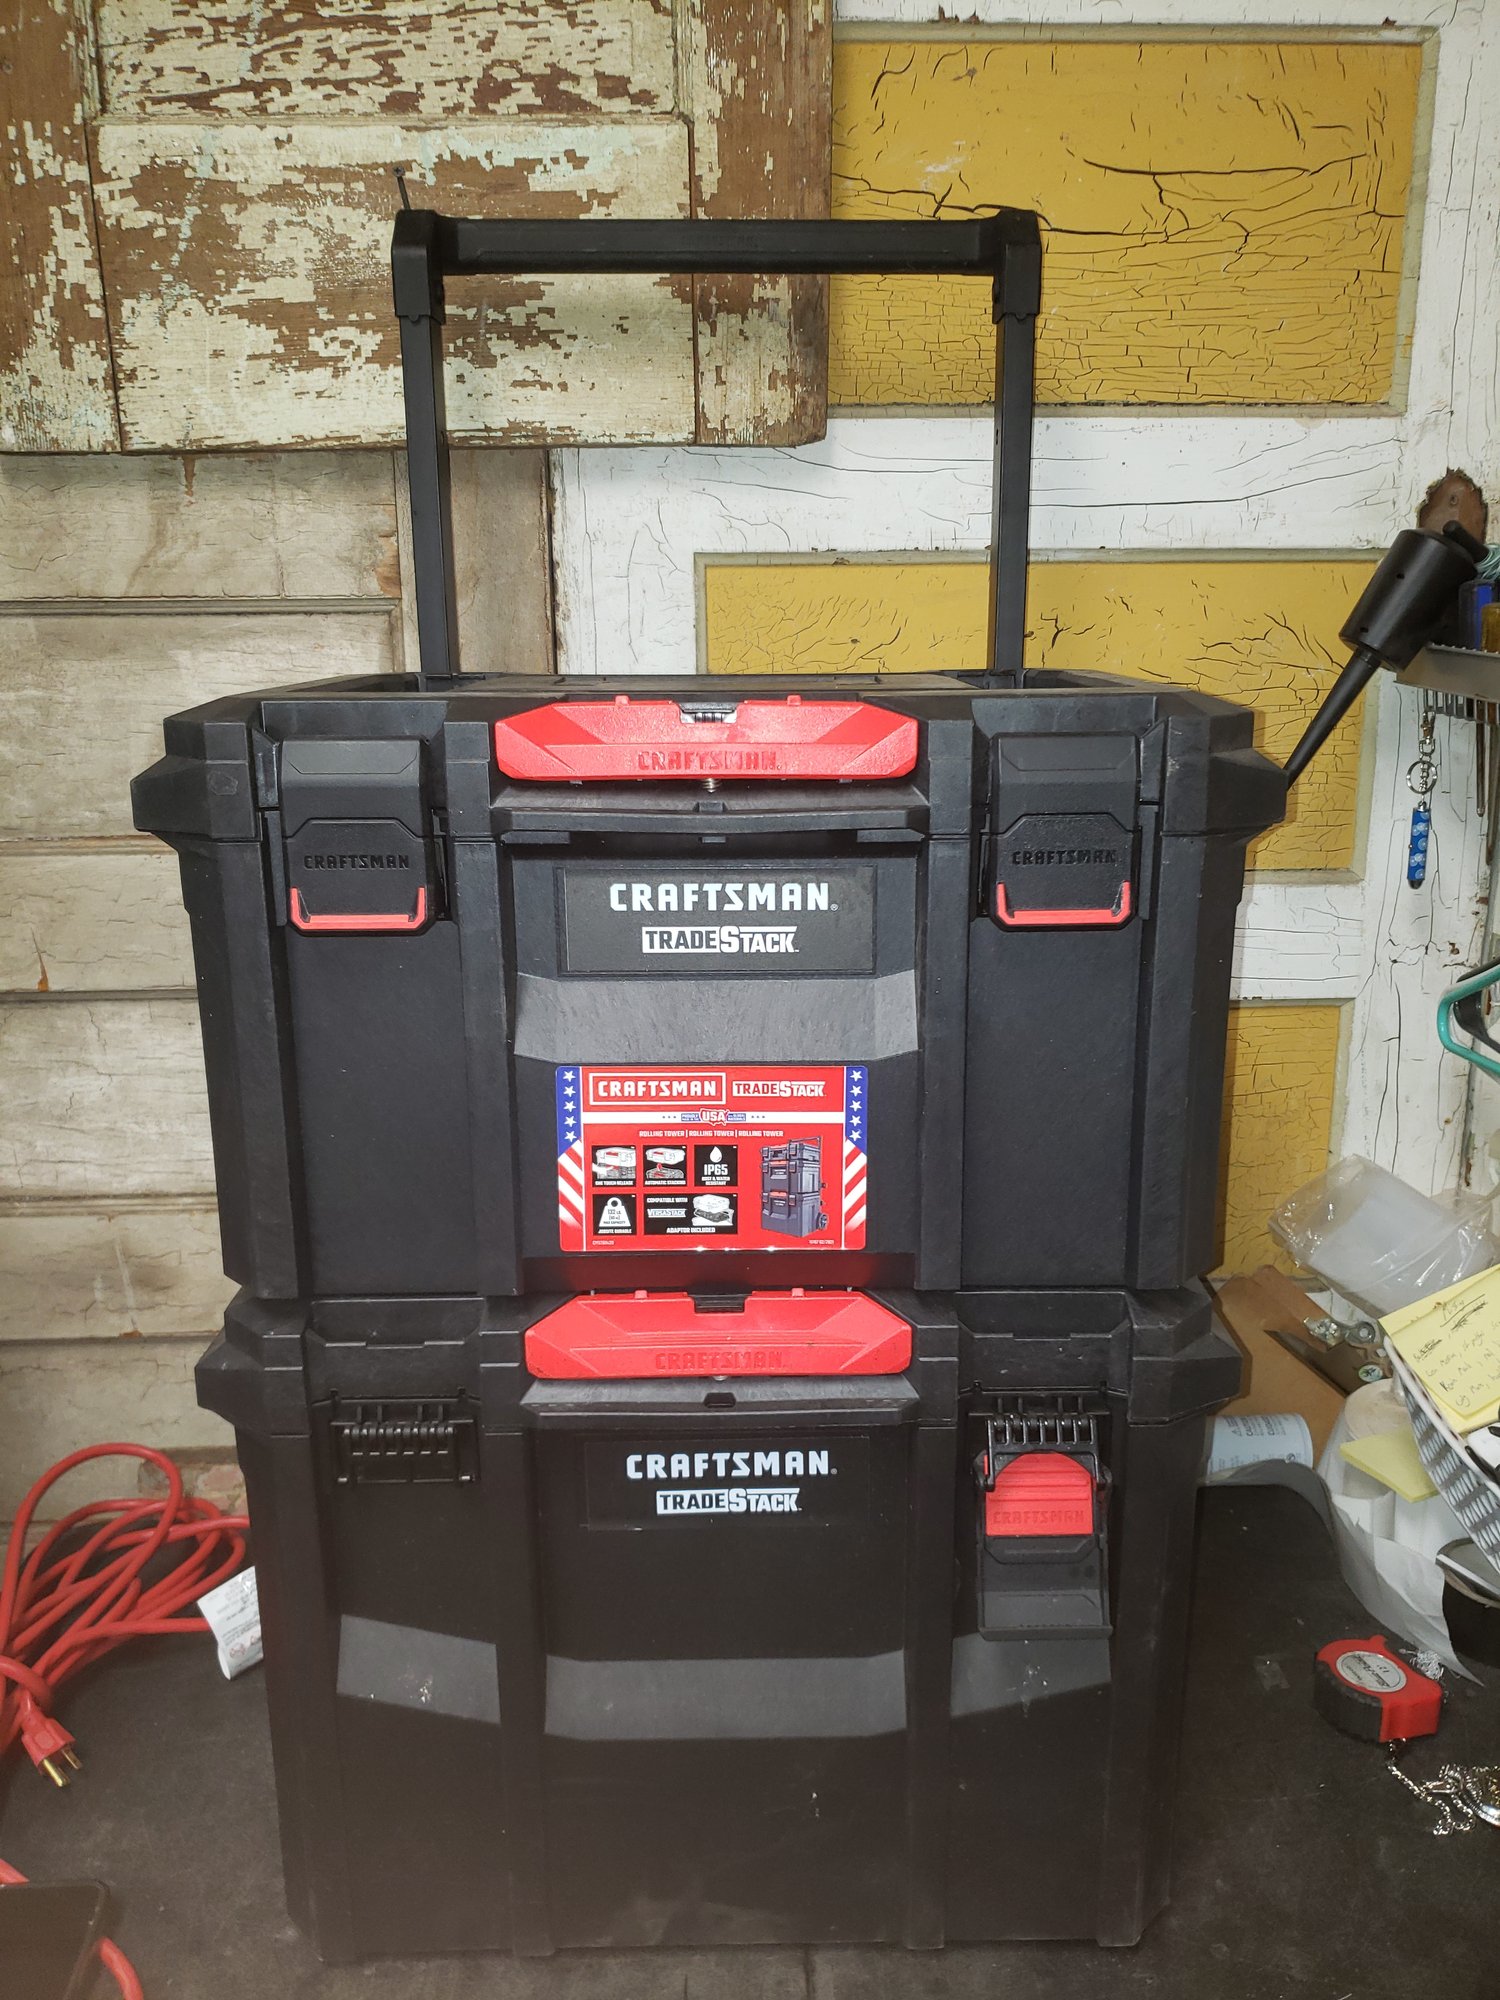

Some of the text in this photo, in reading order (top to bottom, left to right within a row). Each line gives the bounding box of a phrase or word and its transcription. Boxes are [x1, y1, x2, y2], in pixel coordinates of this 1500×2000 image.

[303, 855, 409, 871] CRAFTSMAN
[598, 1080, 717, 1097] CRAFTSMAN
[702, 1111, 726, 1122] USA
[704, 1164, 728, 1175] IP65
[655, 1351, 783, 1370] CRAFTSMAN
